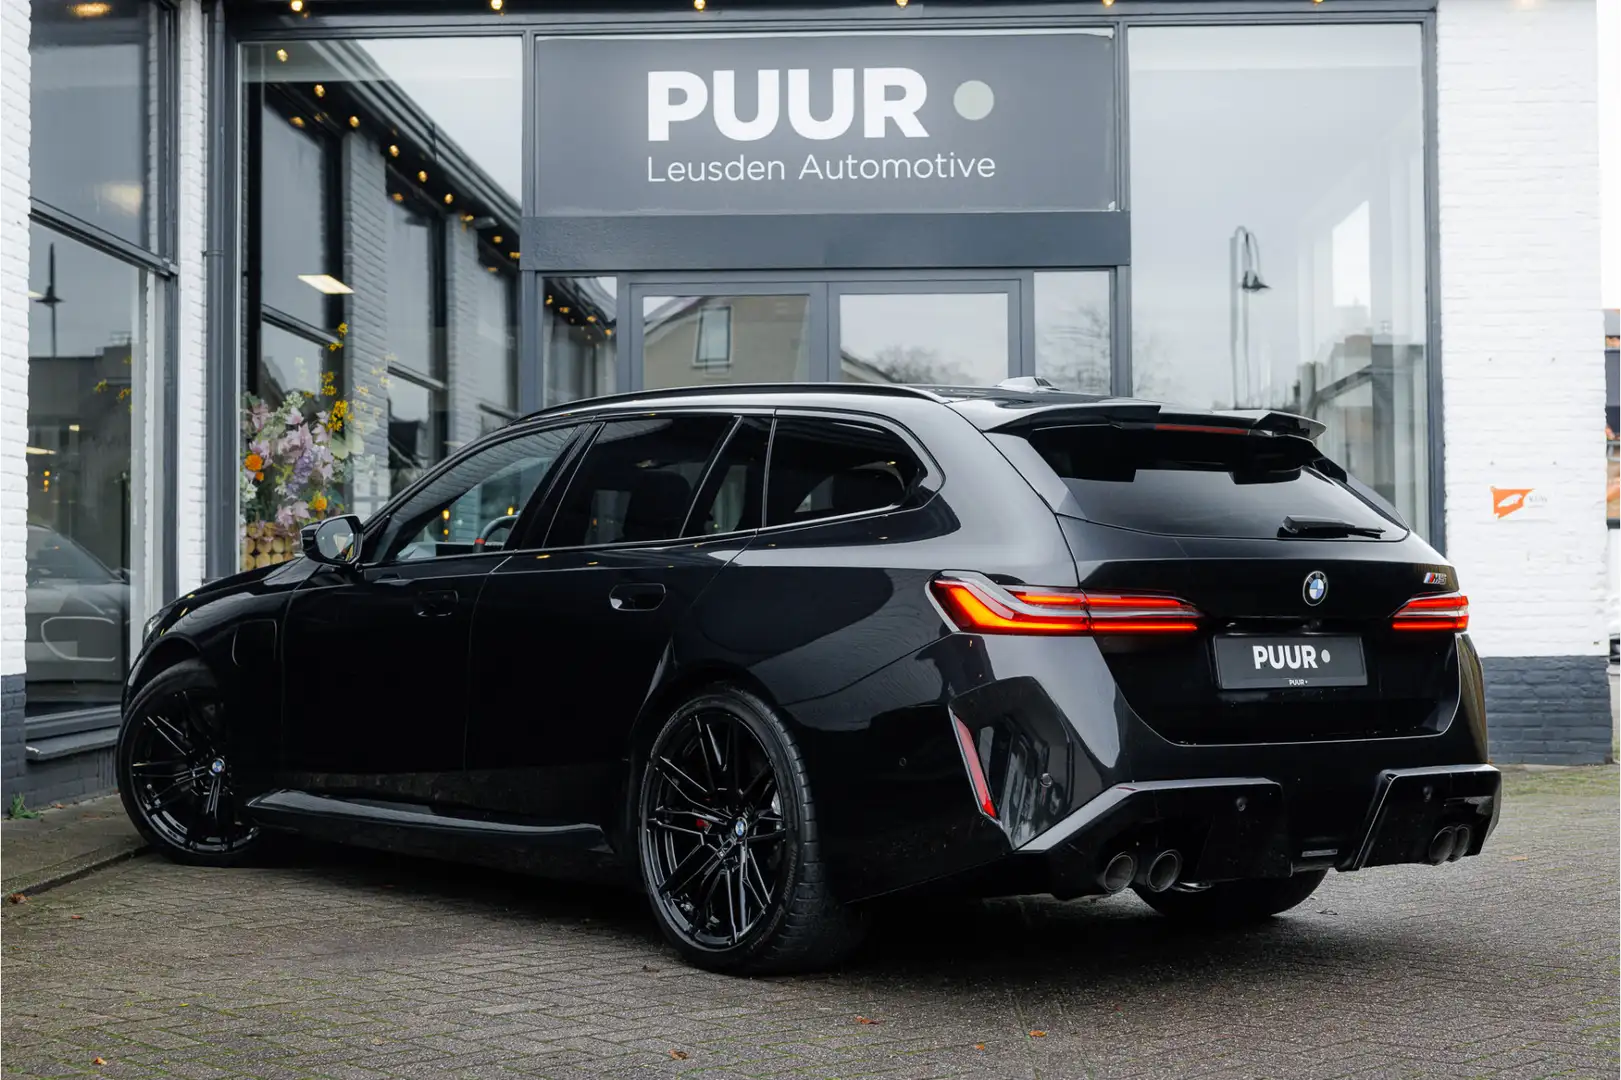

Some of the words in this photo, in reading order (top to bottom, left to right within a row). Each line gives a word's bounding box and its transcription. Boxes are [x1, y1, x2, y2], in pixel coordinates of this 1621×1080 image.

[647, 67, 930, 142] PUUR
[647, 154, 785, 182] Leusden
[799, 152, 996, 181] Automotive
[1252, 645, 1319, 670] PUUR
